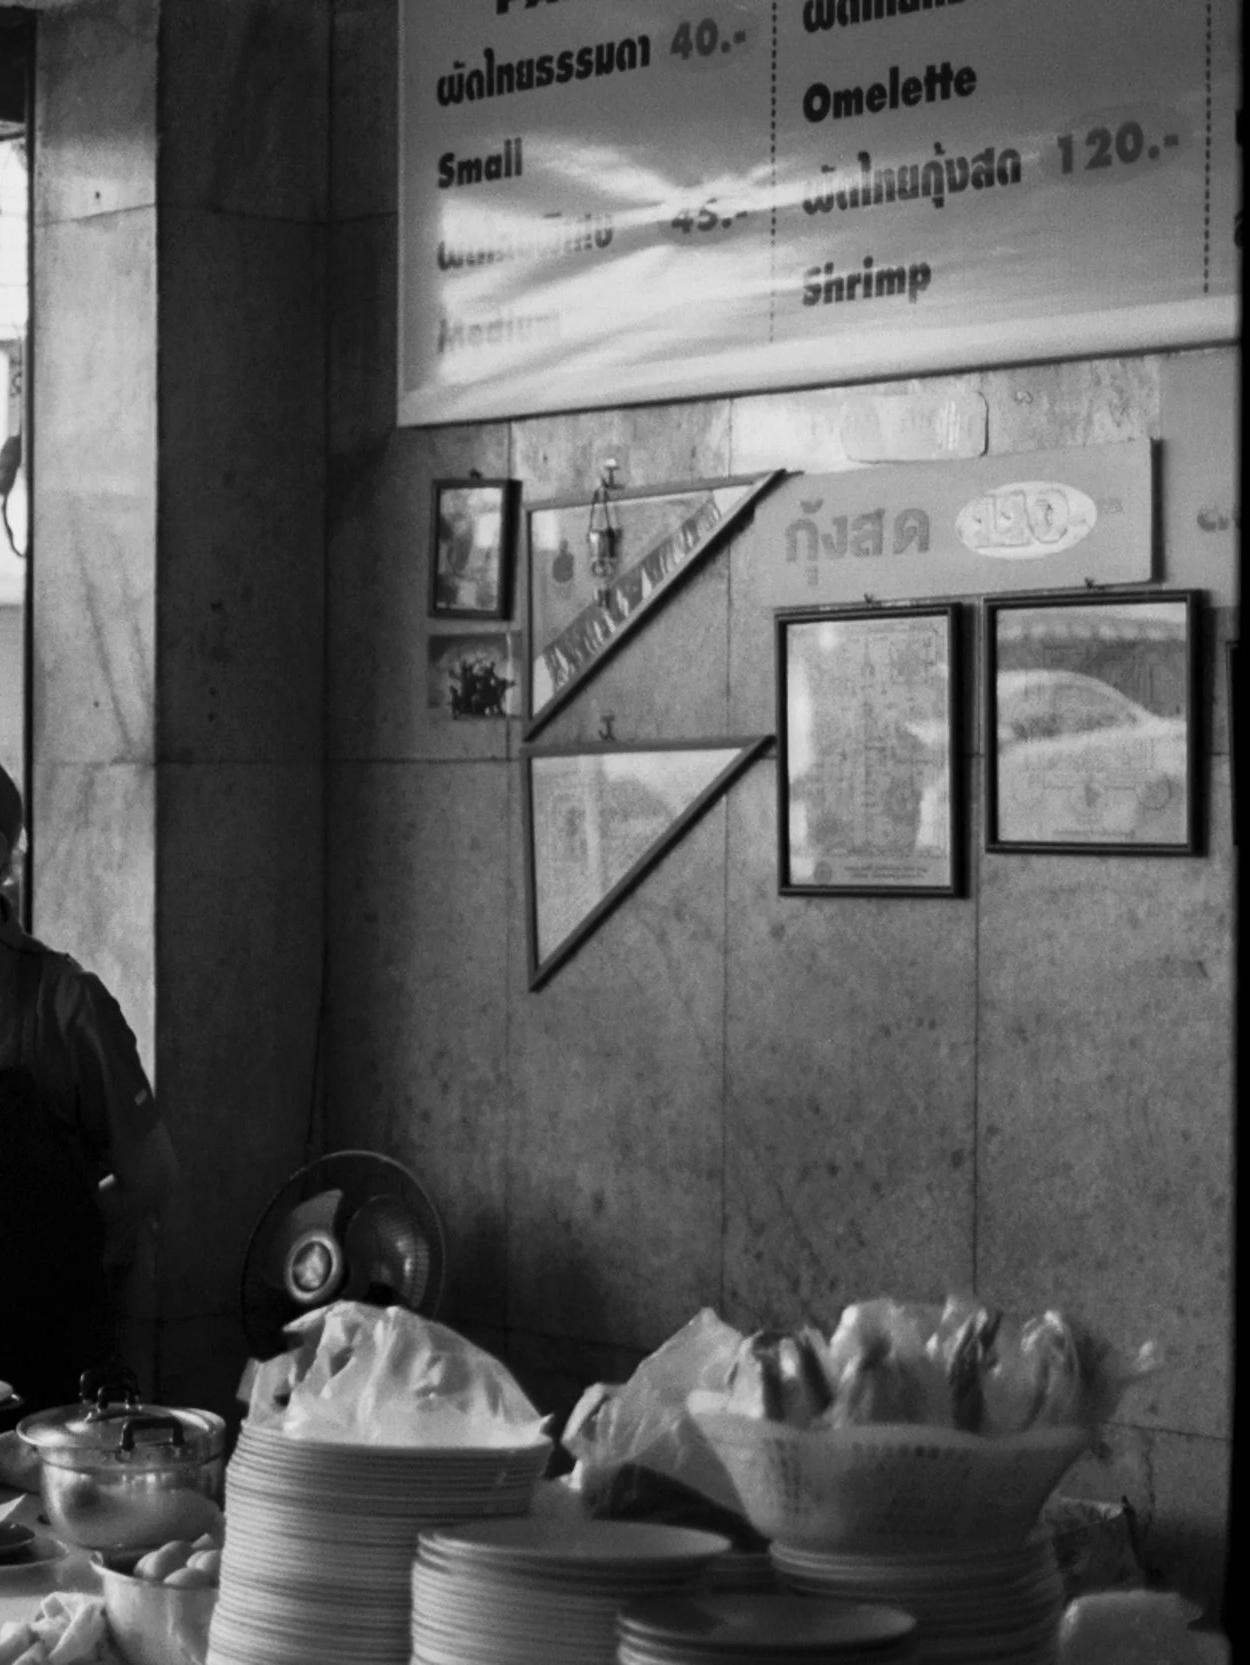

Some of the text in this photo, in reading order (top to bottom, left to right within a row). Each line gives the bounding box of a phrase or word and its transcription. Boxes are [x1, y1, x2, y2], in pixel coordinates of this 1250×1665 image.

[437, 18, 747, 107] ผัดไทยธรรมดา 40.-
[801, 62, 977, 122] Omelette
[437, 137, 523, 188] Small
[802, 255, 932, 307] Shrimp
